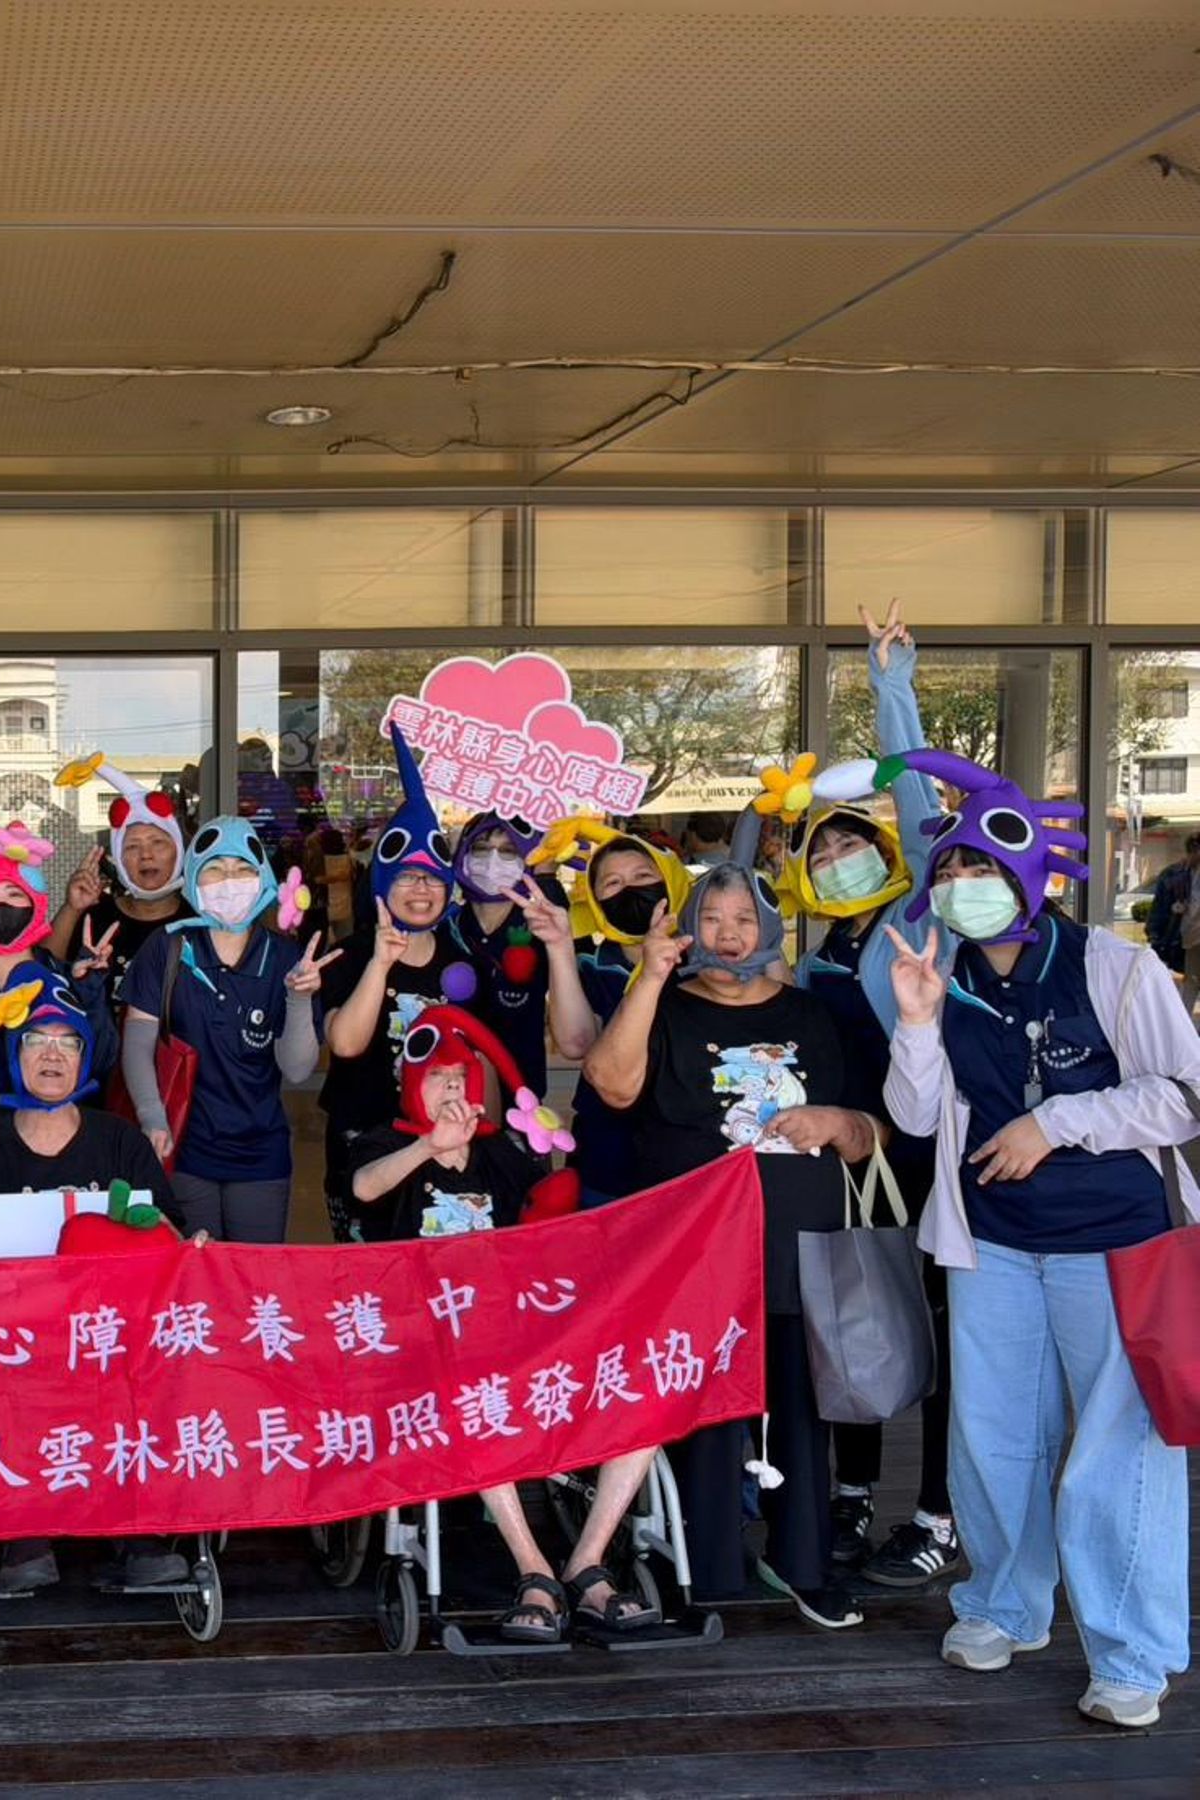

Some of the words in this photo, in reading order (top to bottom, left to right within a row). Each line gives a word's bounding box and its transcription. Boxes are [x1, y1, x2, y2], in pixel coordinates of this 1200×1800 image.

[390, 700, 640, 812] 雲林縣身心障礙
[422, 756, 564, 824] 養護中心
